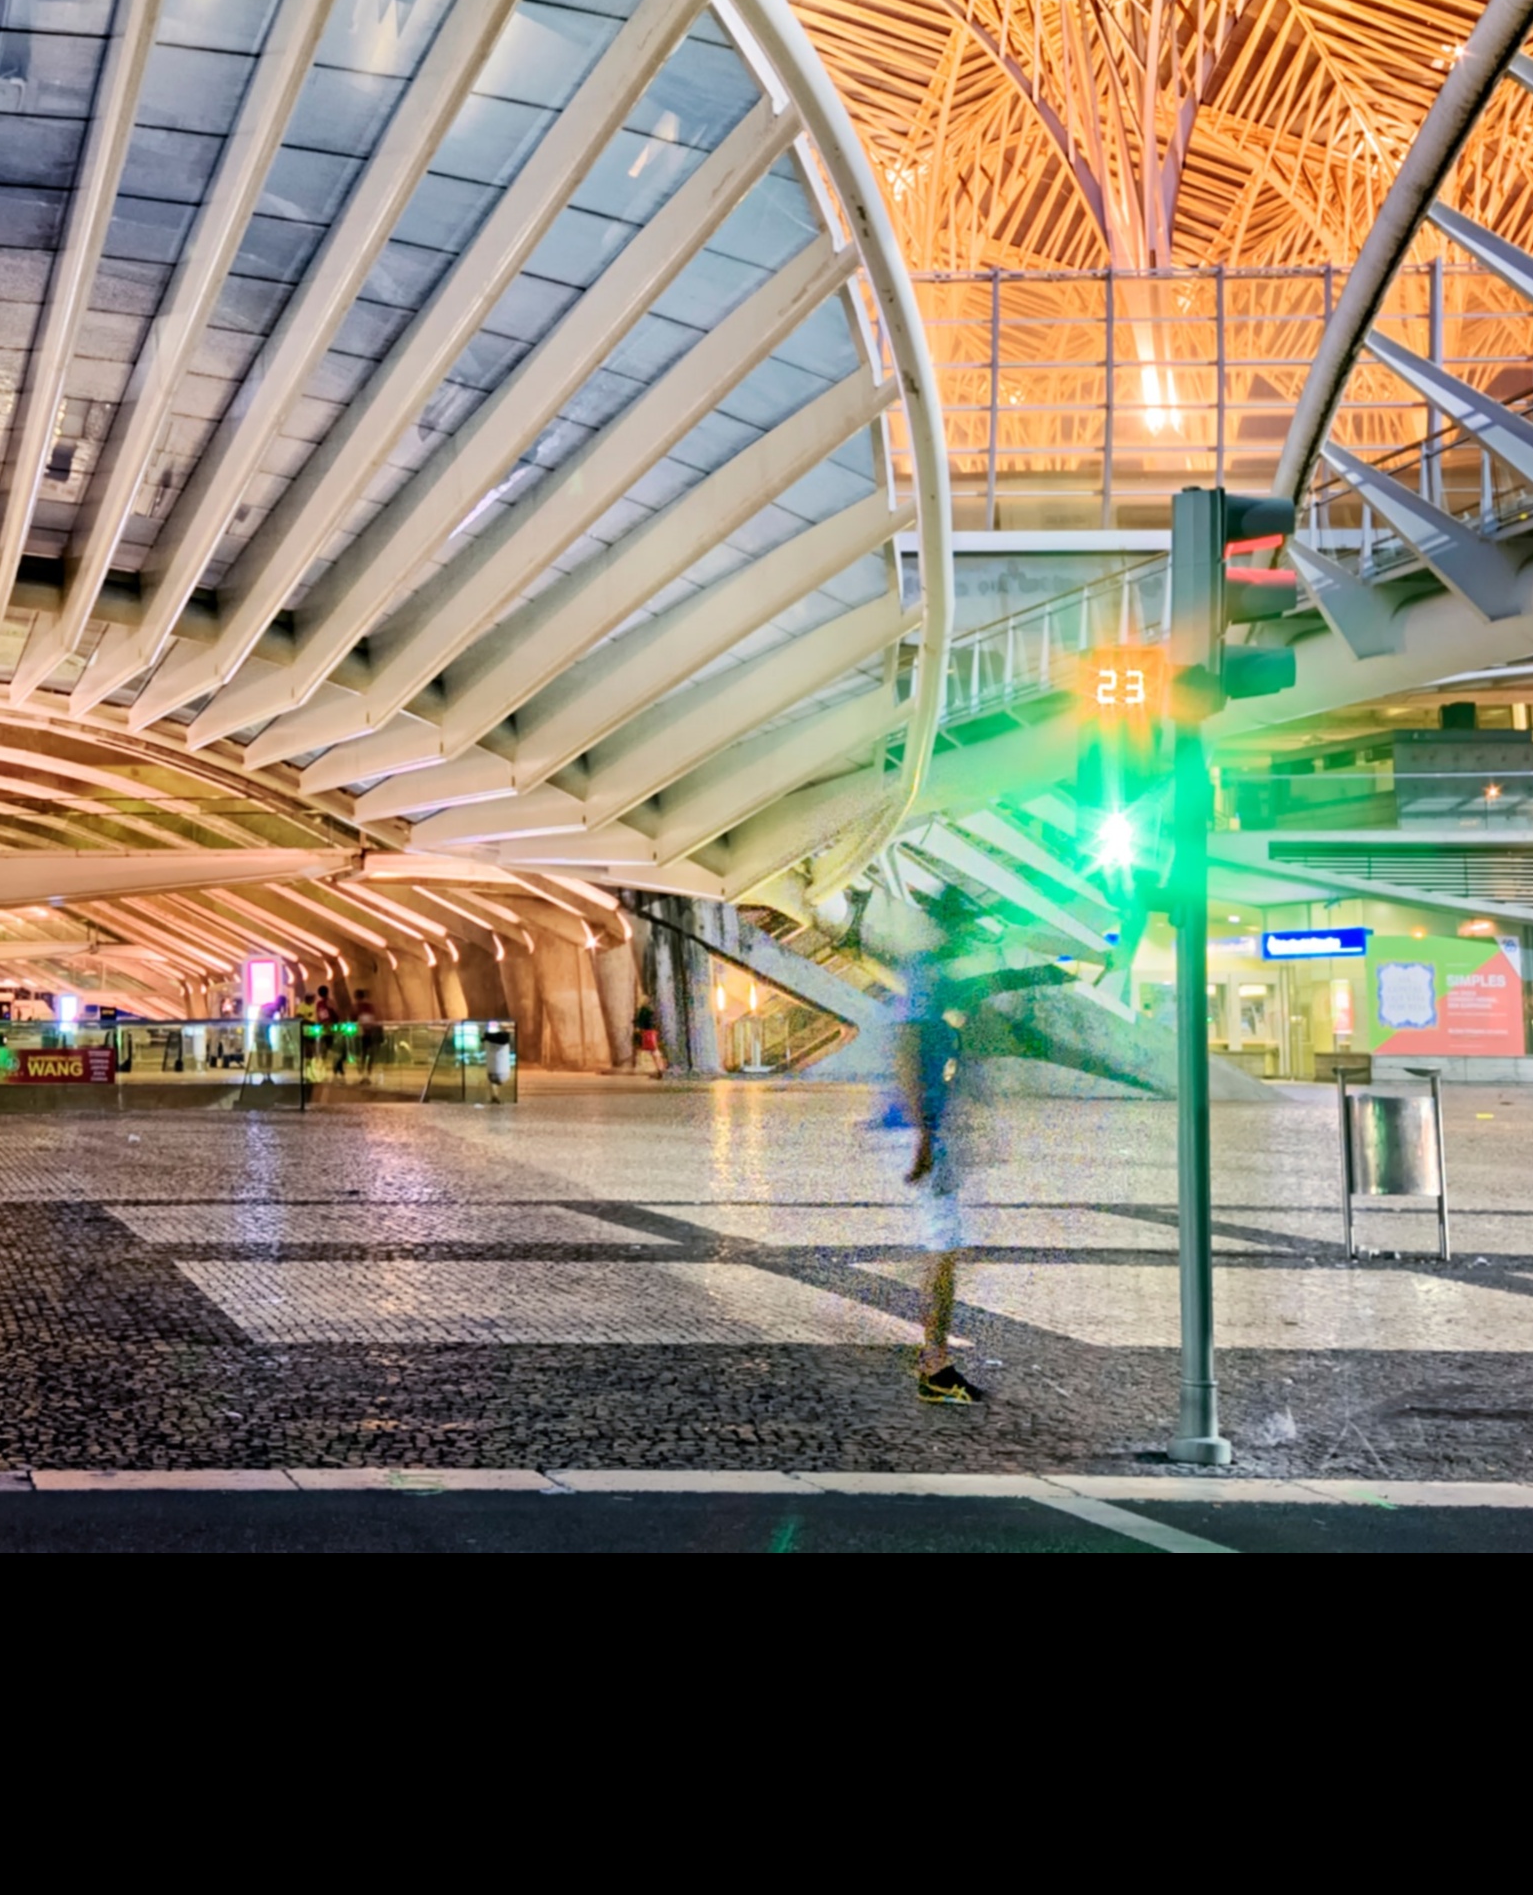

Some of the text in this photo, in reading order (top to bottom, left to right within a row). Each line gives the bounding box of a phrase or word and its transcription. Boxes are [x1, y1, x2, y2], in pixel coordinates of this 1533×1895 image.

[1097, 670, 1145, 704] 23
[1446, 974, 1506, 987] SIMPLES
[27, 1062, 83, 1076] WANG
